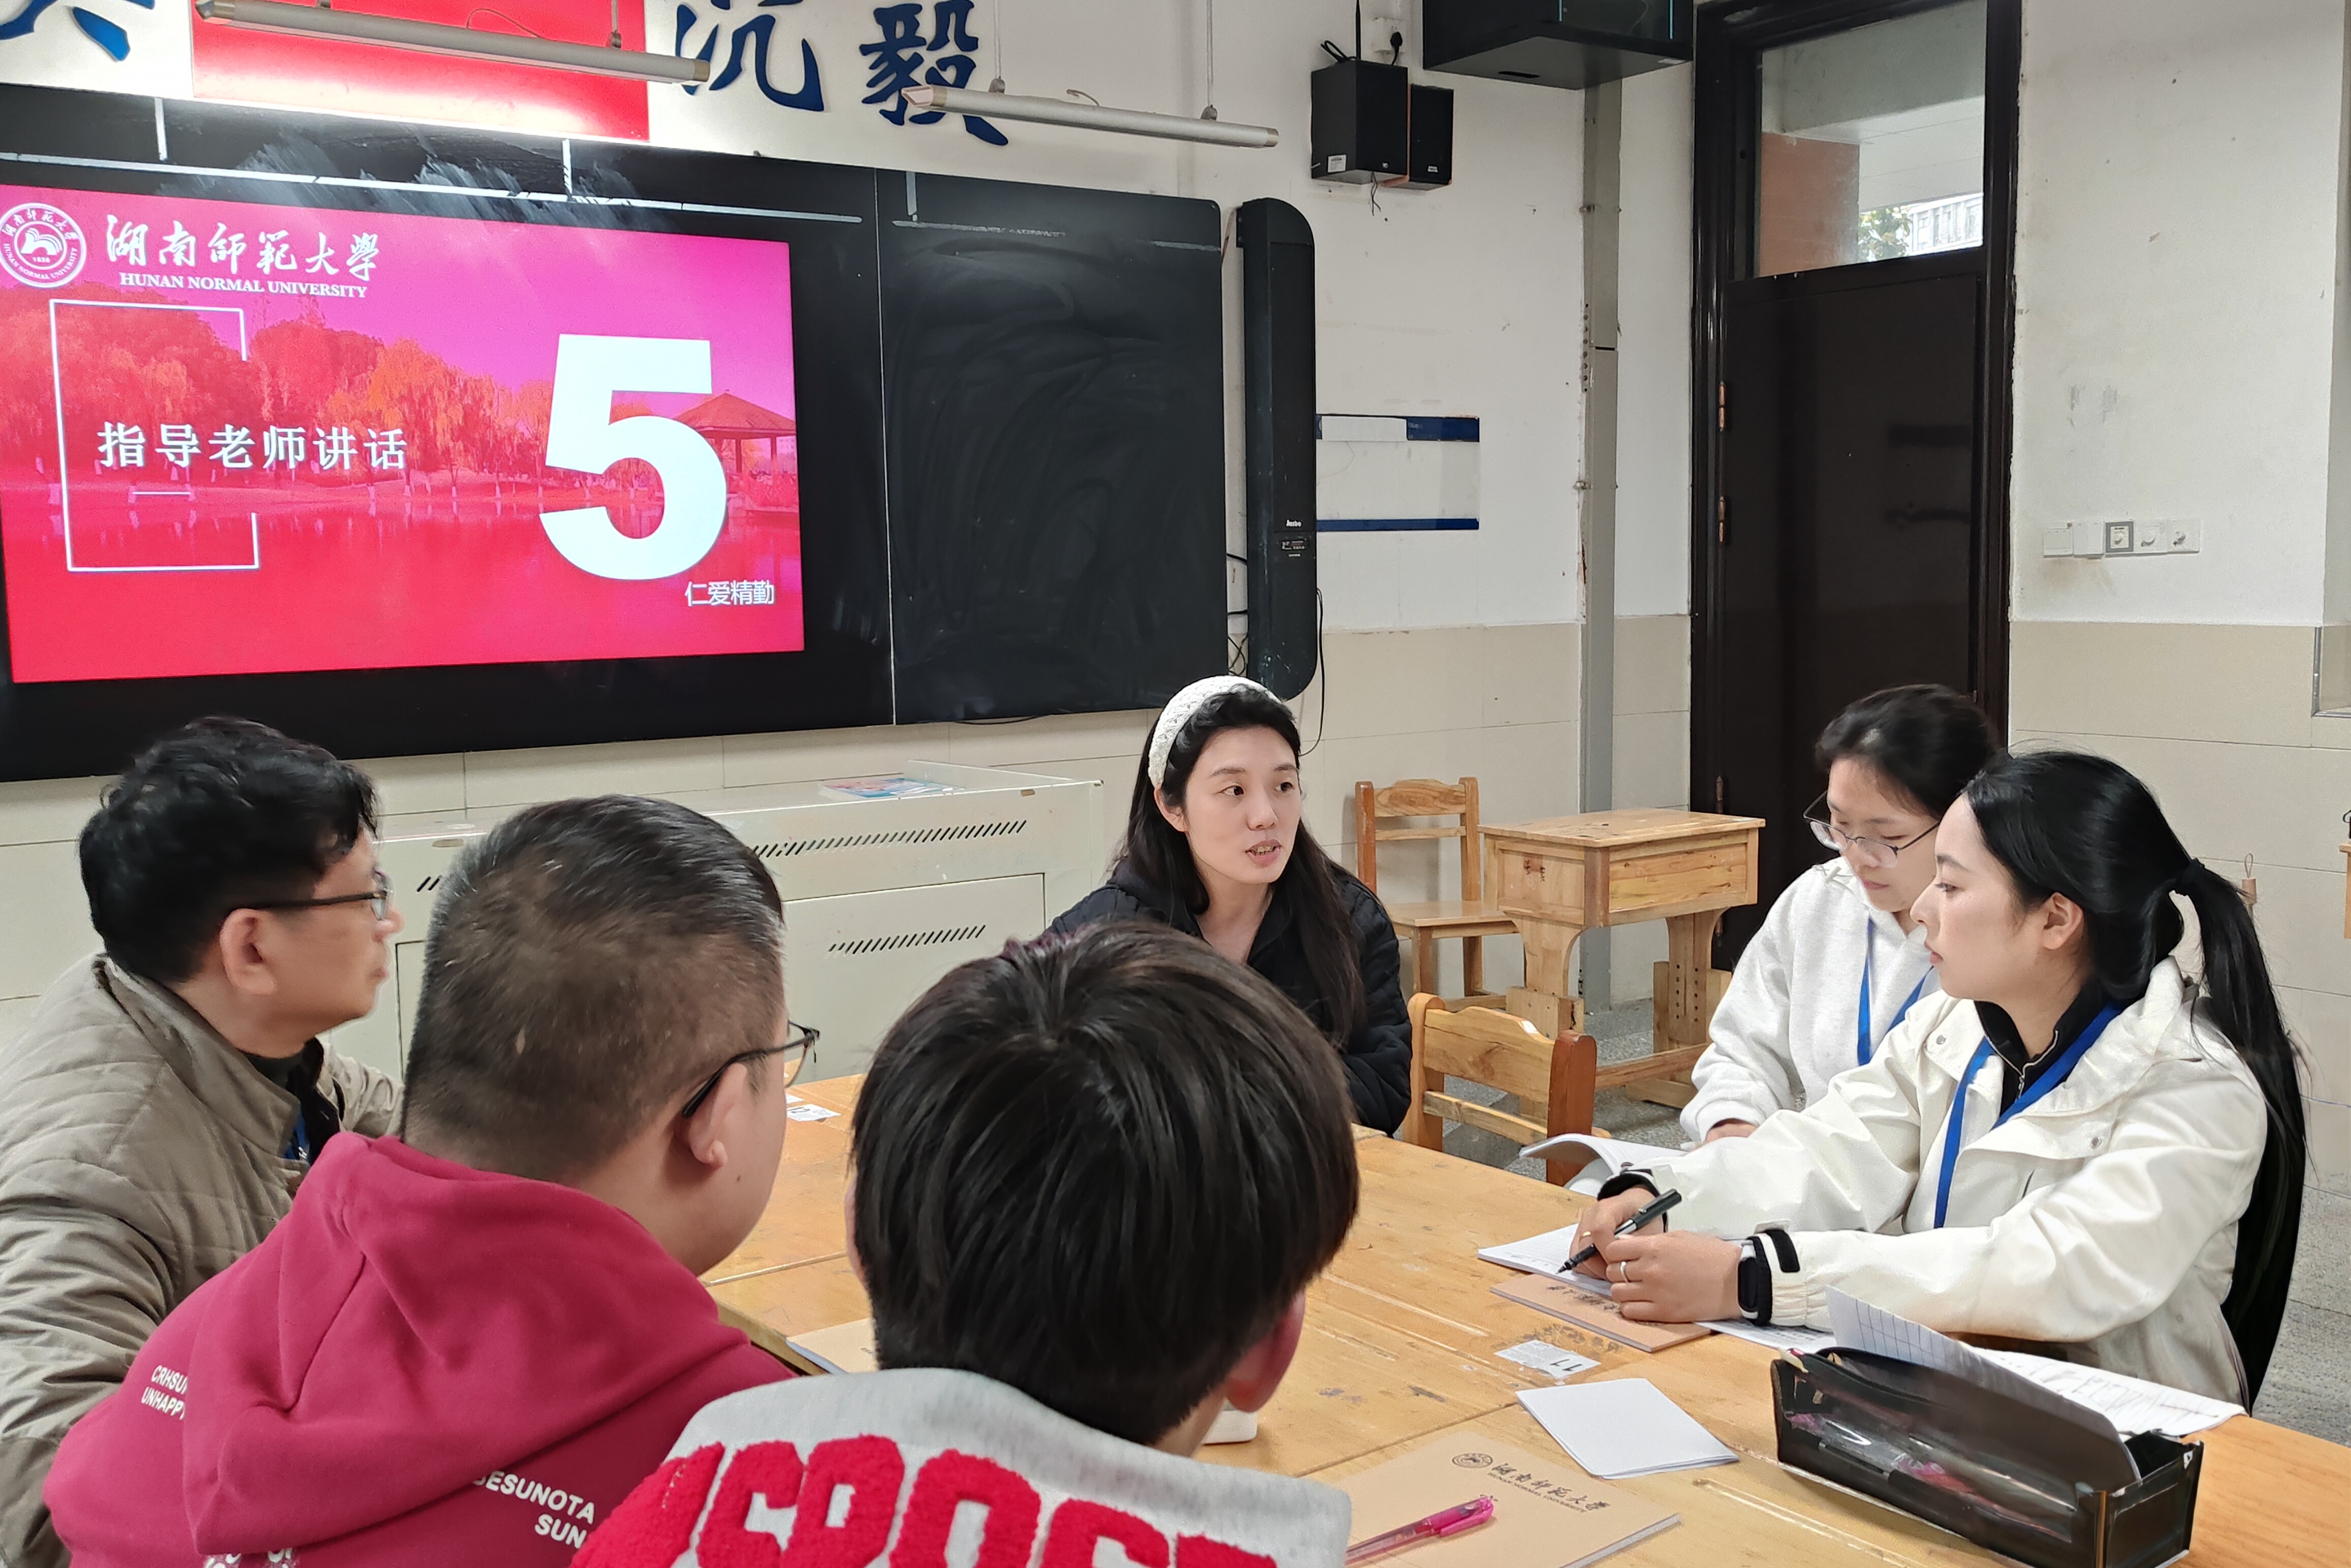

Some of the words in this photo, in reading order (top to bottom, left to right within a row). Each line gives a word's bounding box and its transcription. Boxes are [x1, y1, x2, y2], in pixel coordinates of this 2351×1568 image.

[119, 272, 184, 289] HUNAN
[187, 275, 266, 293] NORMAL
[267, 281, 367, 298] UNIVERSITY
[97, 421, 407, 470] 指导老师讲话
[539, 333, 727, 580] 5
[684, 580, 775, 607] 仁爱精勤
[534, 1513, 587, 1549] SUN
